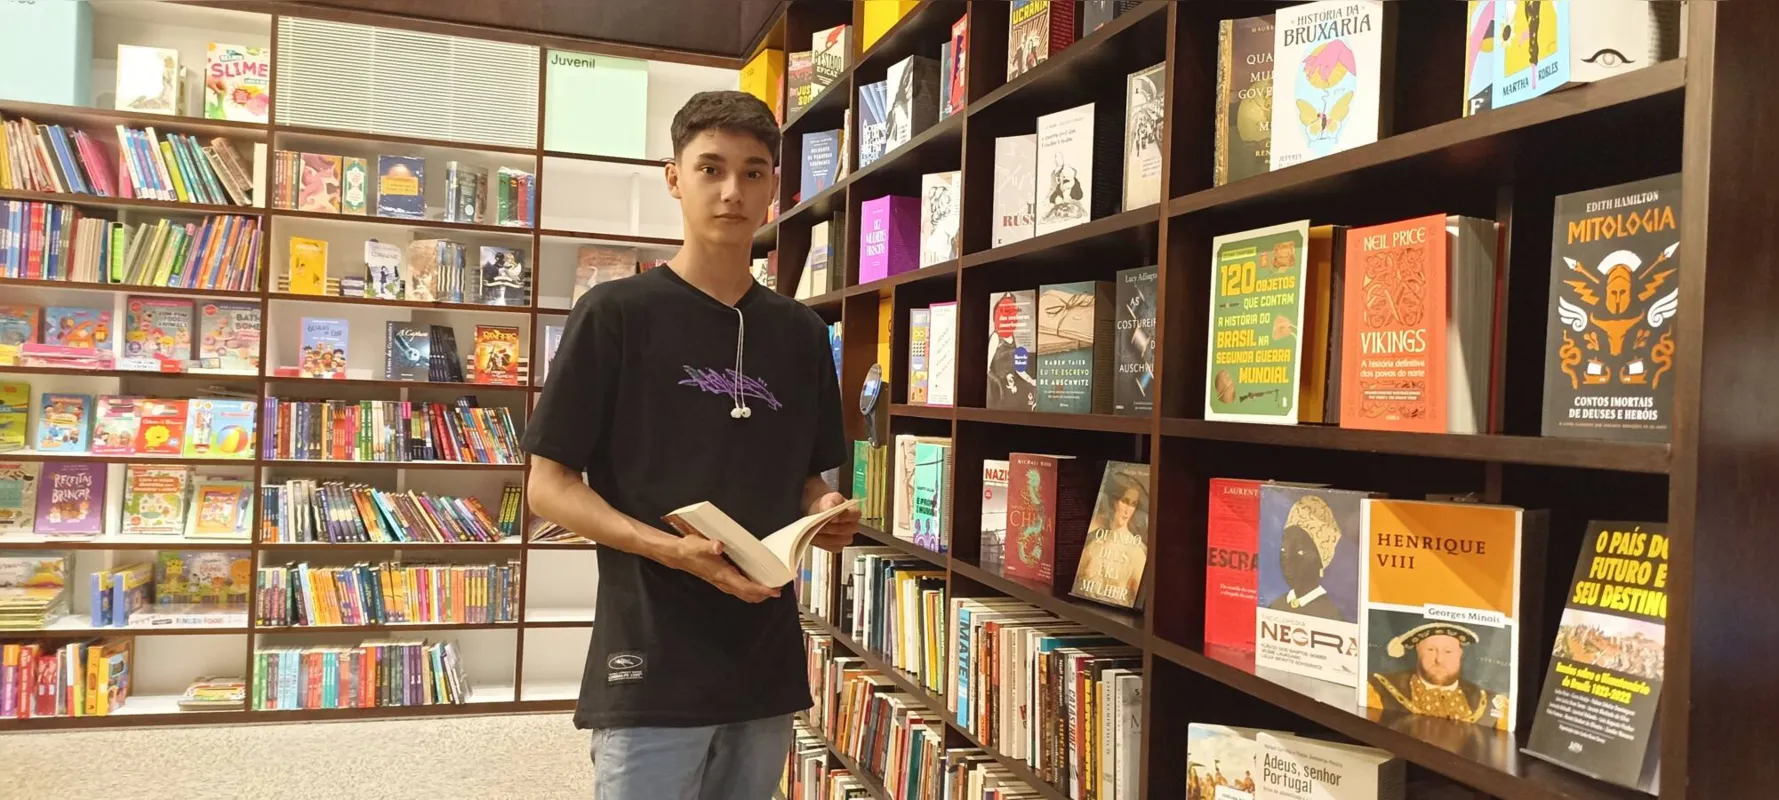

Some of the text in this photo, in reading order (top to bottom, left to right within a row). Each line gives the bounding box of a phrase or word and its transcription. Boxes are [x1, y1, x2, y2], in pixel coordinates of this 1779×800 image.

[1297, 4, 1360, 26] HISTÓRIA DA
[1284, 14, 1372, 47] BRUXARIA
[211, 61, 268, 78] SLIME
[551, 54, 595, 69] Juvenil
[1502, 77, 1529, 97] MARTHA
[1586, 190, 1659, 213] EDITH HAMILTON
[1567, 205, 1676, 245] MITOLOGIA
[1364, 227, 1426, 251] NEIL PRICE
[1219, 261, 1257, 297] 120
[1255, 275, 1296, 292] OBJETOS
[1130, 296, 1140, 306] AS
[1243, 293, 1295, 310] QUE CONTAM
[1217, 312, 1271, 327] A HISTÓRIA DO
[1216, 329, 1269, 348] BRASIL NA
[1361, 328, 1426, 354] VIKINGS
[1216, 348, 1291, 364] SEGUNDA GUERRA
[1238, 366, 1289, 384] MUNDIAL
[1574, 396, 1654, 408] CONTOS IMORTAIS
[1568, 408, 1658, 421] DE DEUSES E HERÓIS
[54, 472, 92, 488] RECEITAS
[985, 468, 1009, 481] NAZI
[51, 488, 92, 504] BRINCAR
[1377, 532, 1486, 555] HENRIQUE
[1596, 530, 1608, 553] O
[1608, 526, 1647, 556] PAÍS
[1377, 553, 1415, 570] VIII
[1589, 556, 1668, 589] FUTURO E
[1080, 579, 1128, 601] MULHER
[1572, 580, 1602, 606] SEU
[1428, 607, 1501, 624] Georges Minois
[1261, 621, 1358, 657] NEGRA
[1263, 753, 1342, 787] Adeus, senhor
[1263, 768, 1313, 794] Portugal
